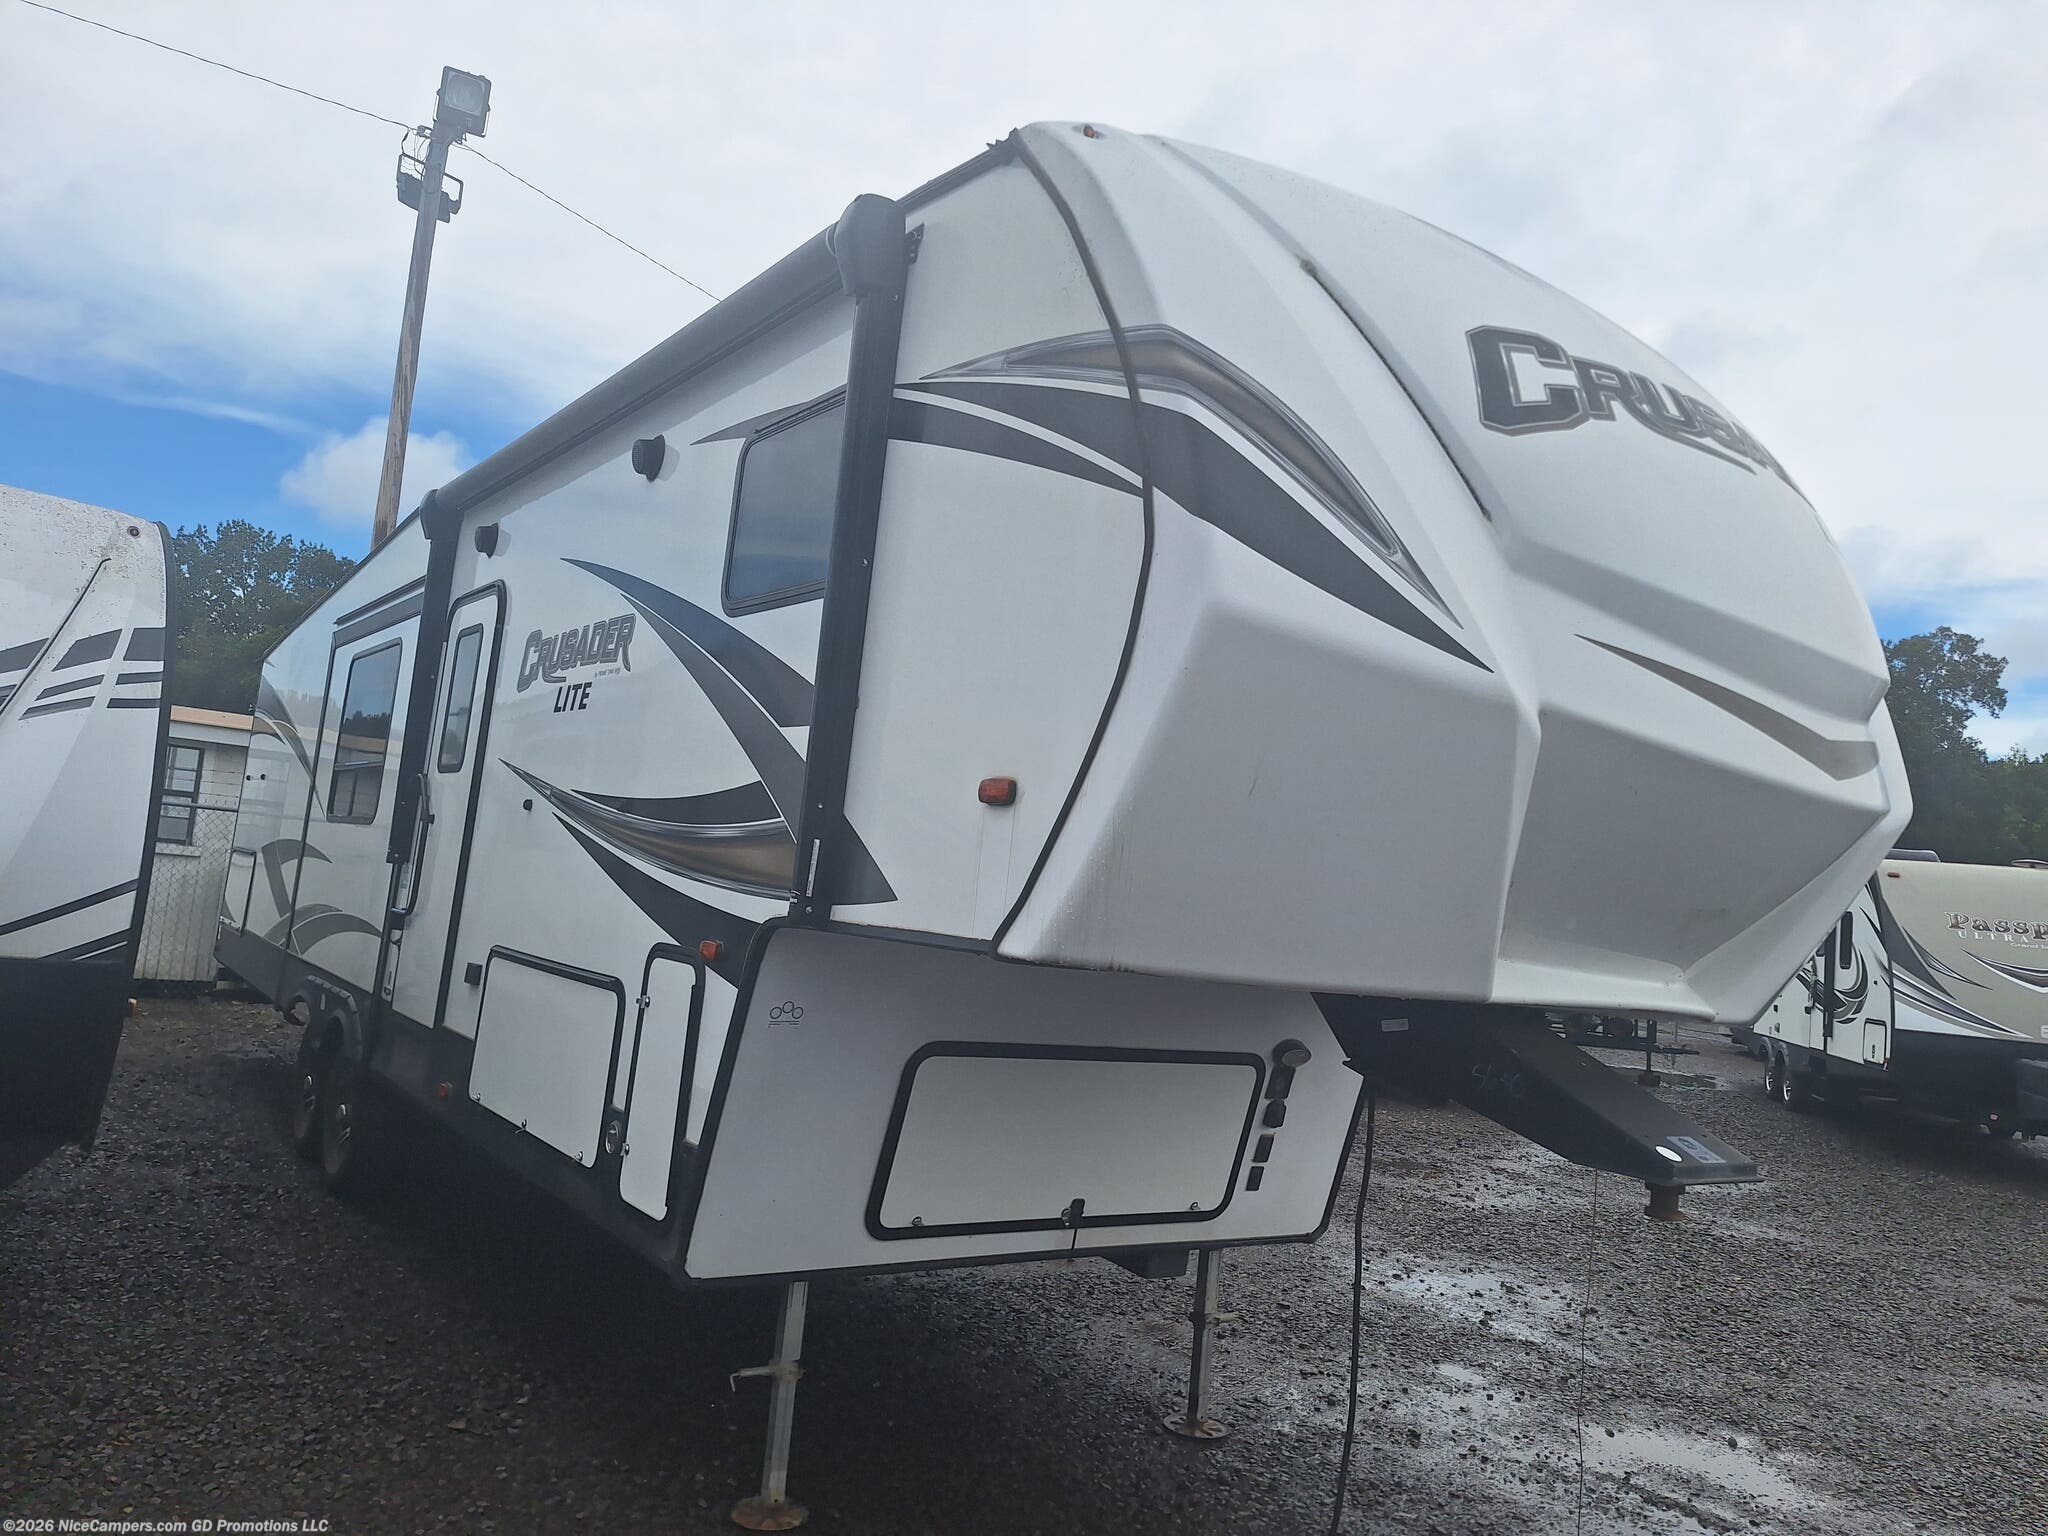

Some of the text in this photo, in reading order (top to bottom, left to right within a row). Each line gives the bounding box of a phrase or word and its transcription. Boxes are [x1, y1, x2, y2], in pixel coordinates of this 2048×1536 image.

[517, 613, 637, 693] CRUSADER
[553, 682, 593, 713] LITE
[1958, 929, 2029, 943] ULTRA
